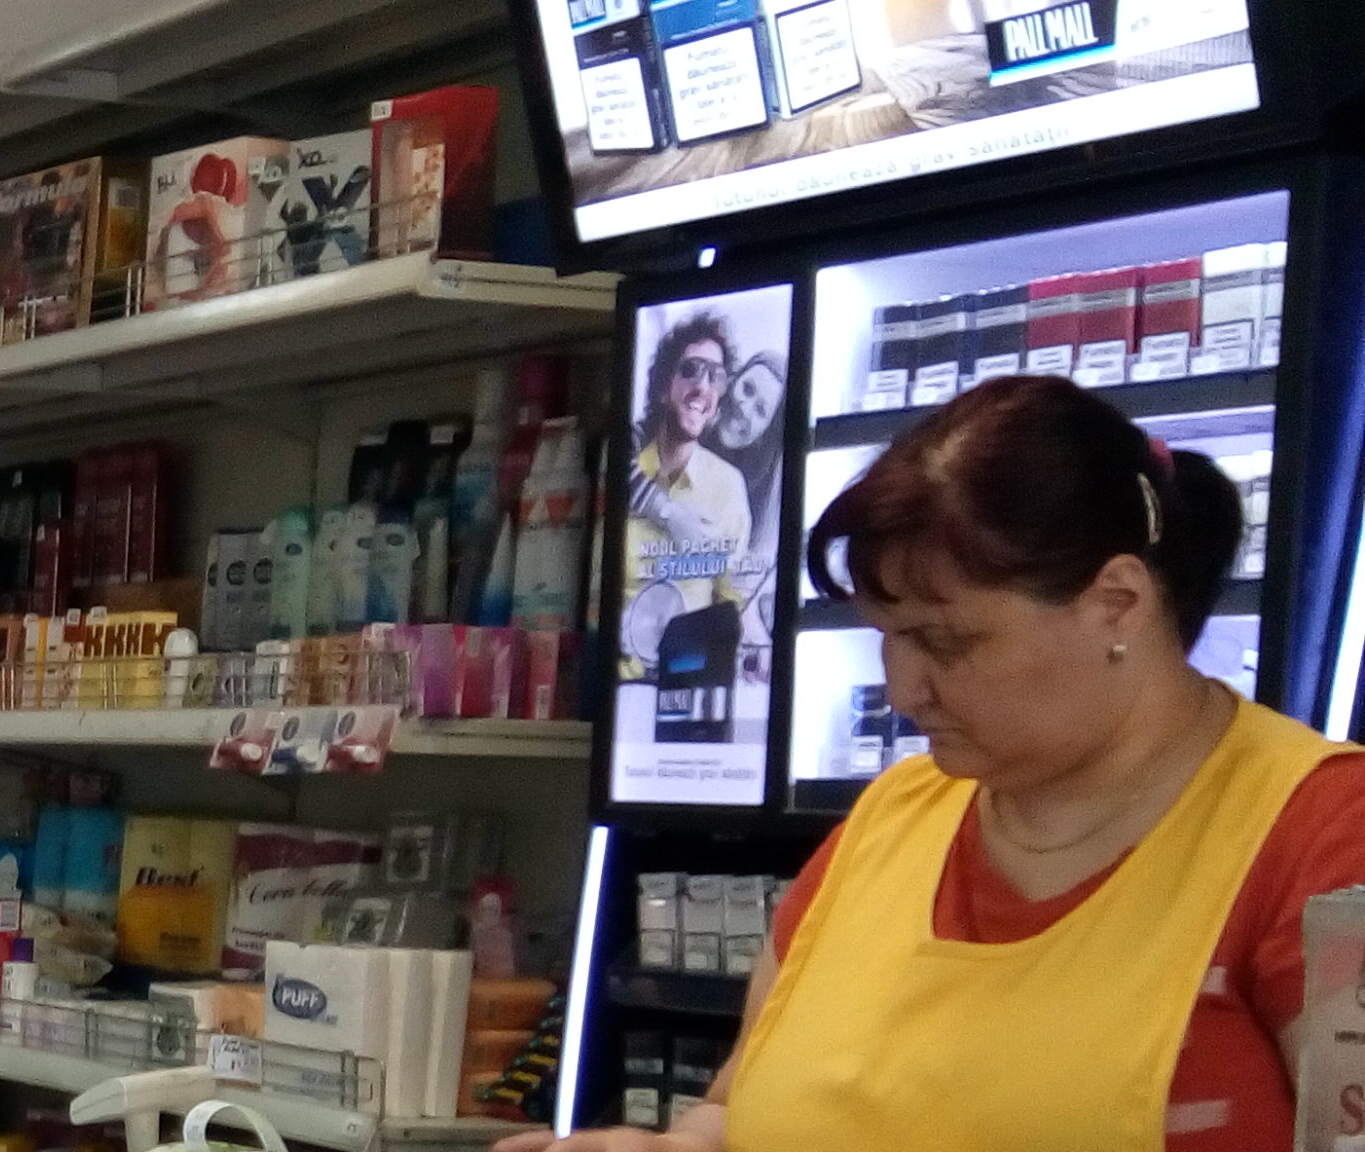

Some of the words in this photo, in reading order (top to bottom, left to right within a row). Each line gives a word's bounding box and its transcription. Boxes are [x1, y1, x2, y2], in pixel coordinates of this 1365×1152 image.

[1003, 14, 1049, 61] PALL
[1045, 1, 1099, 51] MALL
[637, 539, 679, 558] NOUL
[681, 536, 741, 557] PACHET
[281, 988, 320, 1009] PUFF
